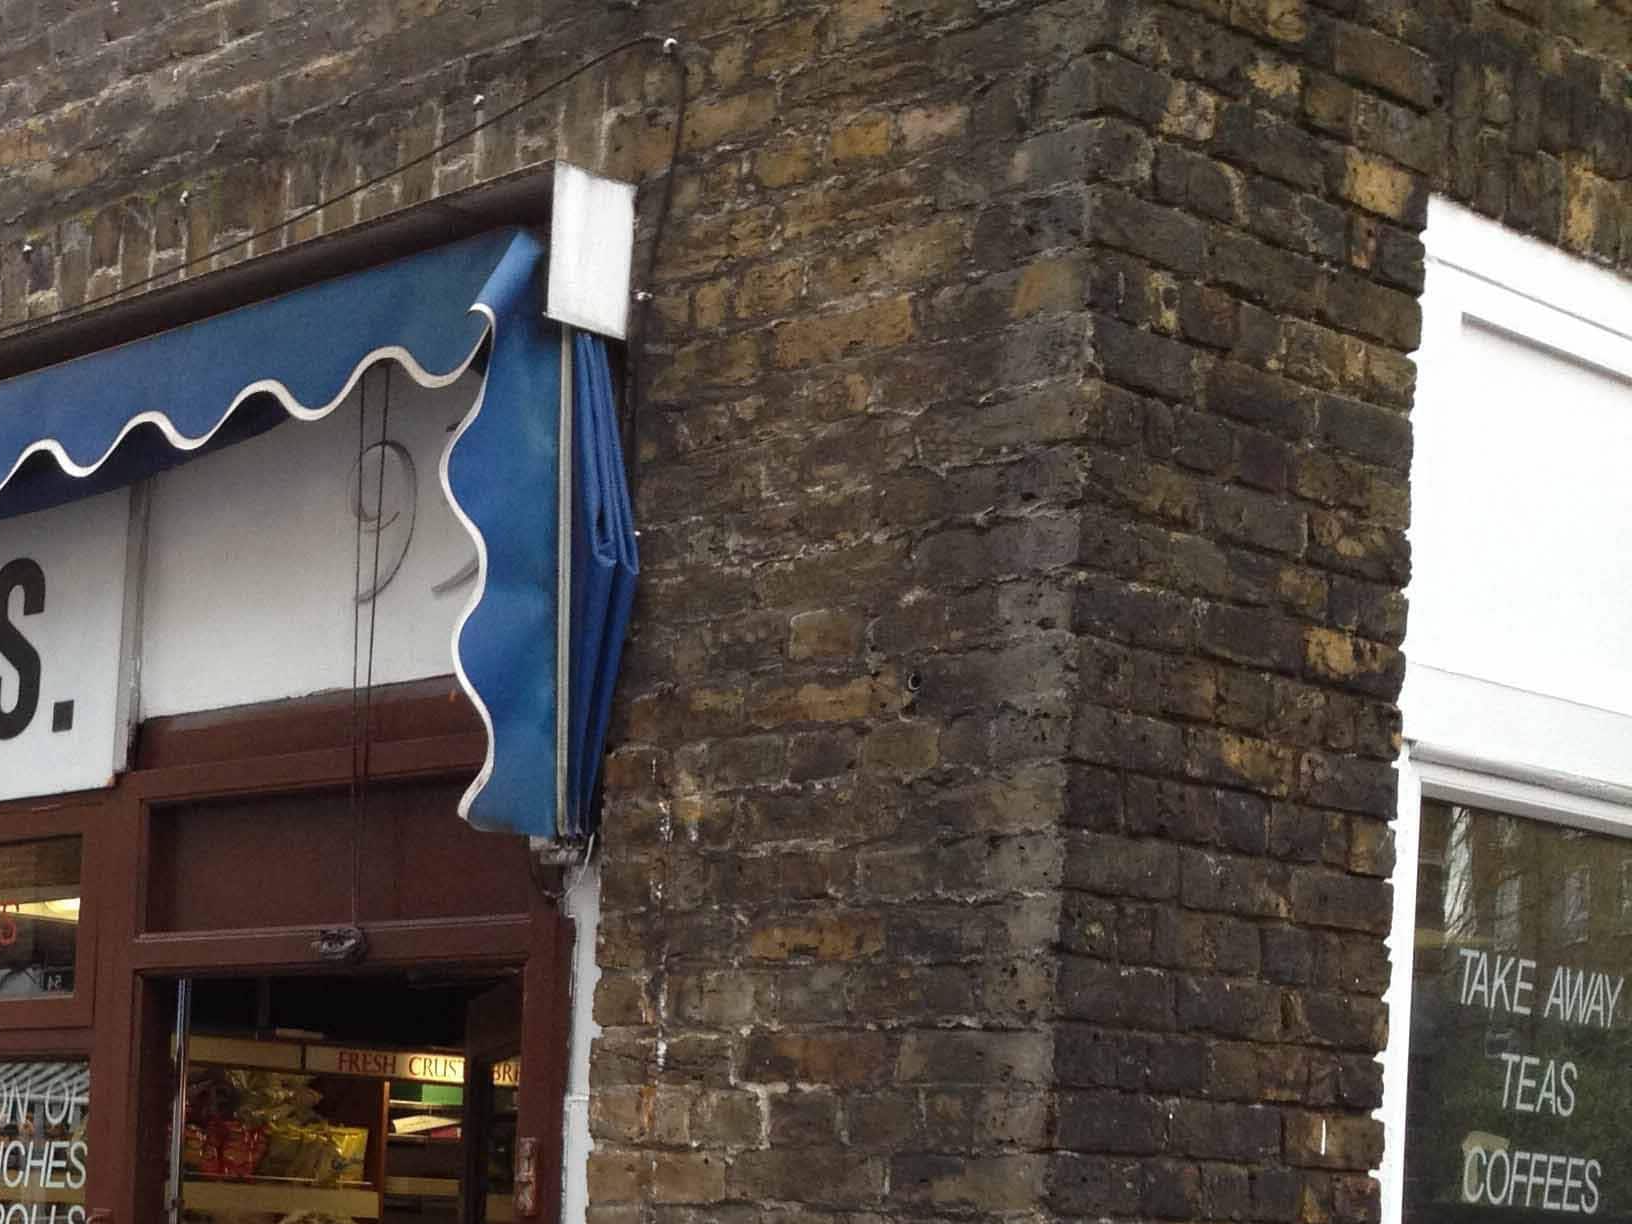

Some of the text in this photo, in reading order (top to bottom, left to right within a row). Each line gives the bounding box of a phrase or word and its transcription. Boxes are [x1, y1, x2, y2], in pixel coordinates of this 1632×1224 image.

[1459, 948, 1625, 1029] TAKE AWAY
[338, 1050, 397, 1074] FRESH
[1500, 1052, 1579, 1117] TEAS
[44, 1080, 89, 1126] OF
[1463, 1146, 1602, 1215] COFFEES
